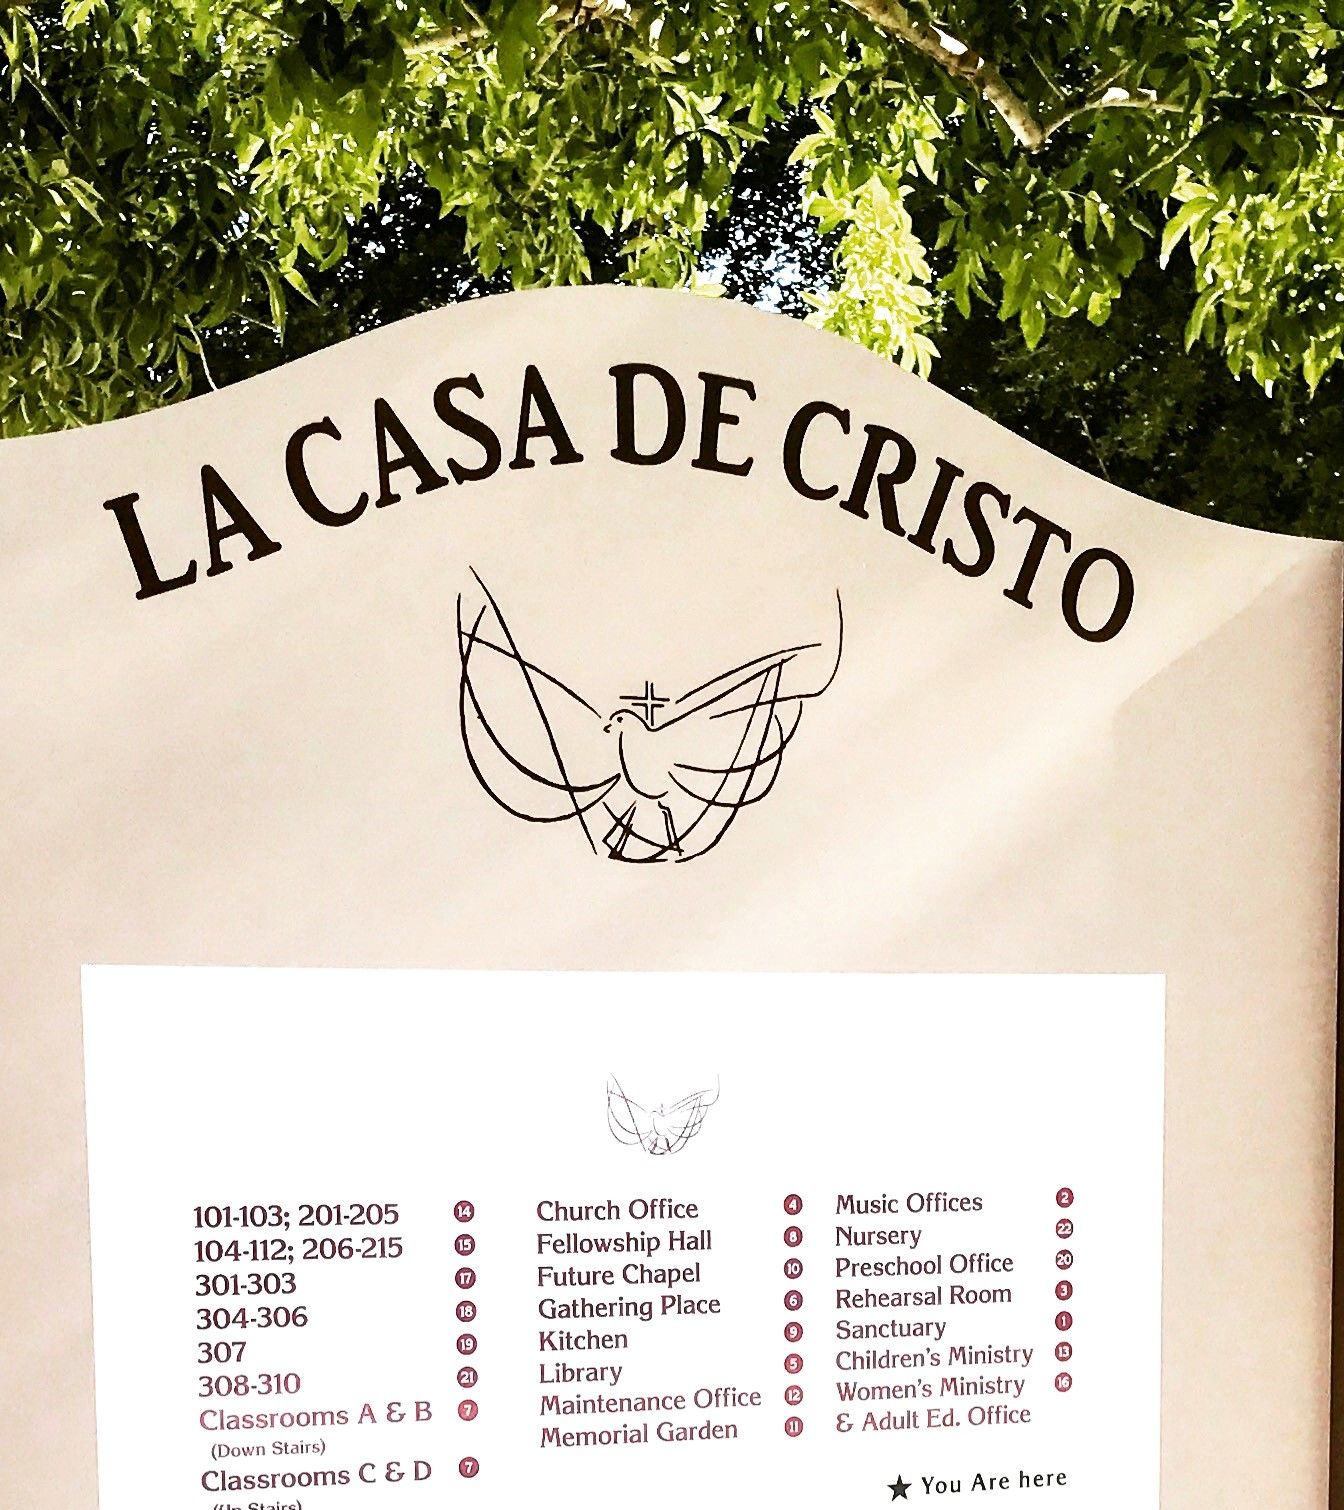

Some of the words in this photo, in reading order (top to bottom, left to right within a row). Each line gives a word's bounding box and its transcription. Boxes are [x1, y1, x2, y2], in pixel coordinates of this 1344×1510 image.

[103, 465, 282, 600] LA
[286, 365, 583, 527] CASA
[609, 363, 756, 476] DE
[783, 400, 1135, 643] CRISTO
[537, 1200, 620, 1221] Church
[629, 1198, 698, 1220] Office
[789, 1198, 797, 1211] 4
[836, 1194, 898, 1214] Music
[907, 1192, 982, 1213] Offices
[1061, 1192, 1069, 1203] 2
[194, 1205, 290, 1231] 101-103;
[299, 1204, 399, 1226] 201-205
[457, 1205, 471, 1218] 14
[537, 1231, 660, 1257] Fellowship
[669, 1230, 711, 1251] Hall
[789, 1231, 797, 1243] 8
[836, 1226, 922, 1249] Nursery
[1057, 1222, 1073, 1234] 22
[194, 1239, 294, 1264] 104-112;
[303, 1237, 402, 1259] 206-215
[458, 1239, 471, 1251] 15
[538, 1266, 614, 1287] Future
[623, 1262, 700, 1288] Chapel
[786, 1263, 801, 1275] 10
[836, 1255, 941, 1277] Preschool
[950, 1253, 1013, 1273] Office
[1056, 1253, 1072, 1266] 20
[196, 1273, 296, 1296] 301-303
[458, 1272, 472, 1284] 17
[837, 1286, 941, 1309] Rehearsal
[950, 1285, 1011, 1304] Room
[1060, 1285, 1068, 1297] 3
[197, 1306, 308, 1330] 304-306
[459, 1306, 472, 1318] 18
[539, 1297, 652, 1321] Gathering
[661, 1295, 720, 1315] Place
[789, 1295, 797, 1307] 6
[539, 1330, 627, 1351] Kitchen
[789, 1326, 797, 1338] 9
[837, 1320, 946, 1341] Sanctuary
[1061, 1315, 1066, 1327] 1
[198, 1341, 246, 1363] 307
[460, 1338, 473, 1351] 19
[836, 1348, 940, 1370] Children's
[948, 1345, 1033, 1367] Ministry
[1057, 1346, 1070, 1358] 13
[199, 1373, 300, 1397] 308-310
[460, 1371, 475, 1383] 21
[540, 1363, 622, 1386] Library
[789, 1358, 797, 1370] 5
[540, 1394, 685, 1416] Maintenance
[694, 1387, 761, 1408] Office
[786, 1389, 800, 1401] 12
[836, 1379, 932, 1401] Women's
[940, 1376, 1025, 1398] Ministry
[1056, 1376, 1069, 1388] 16
[200, 1409, 348, 1430] Classrooms
[358, 1403, 377, 1424] A
[387, 1402, 406, 1422] &
[415, 1401, 432, 1421] B
[464, 1404, 471, 1416] 7
[836, 1413, 853, 1432] &
[862, 1410, 919, 1431] Adult
[927, 1408, 960, 1428] Ed.
[968, 1405, 1030, 1425] Office
[541, 1423, 648, 1448] Memorial
[657, 1420, 737, 1441] Garden
[788, 1421, 798, 1433] 11
[211, 1444, 265, 1461] (Down
[272, 1439, 325, 1455] Stairs)
[201, 1470, 350, 1491] Classrooms
[359, 1463, 376, 1483] C
[385, 1462, 405, 1482] &
[414, 1461, 431, 1480] D
[465, 1461, 472, 1473] 7
[922, 1476, 960, 1494] You
[971, 1473, 1009, 1491] Are
[1020, 1470, 1066, 1488] here
